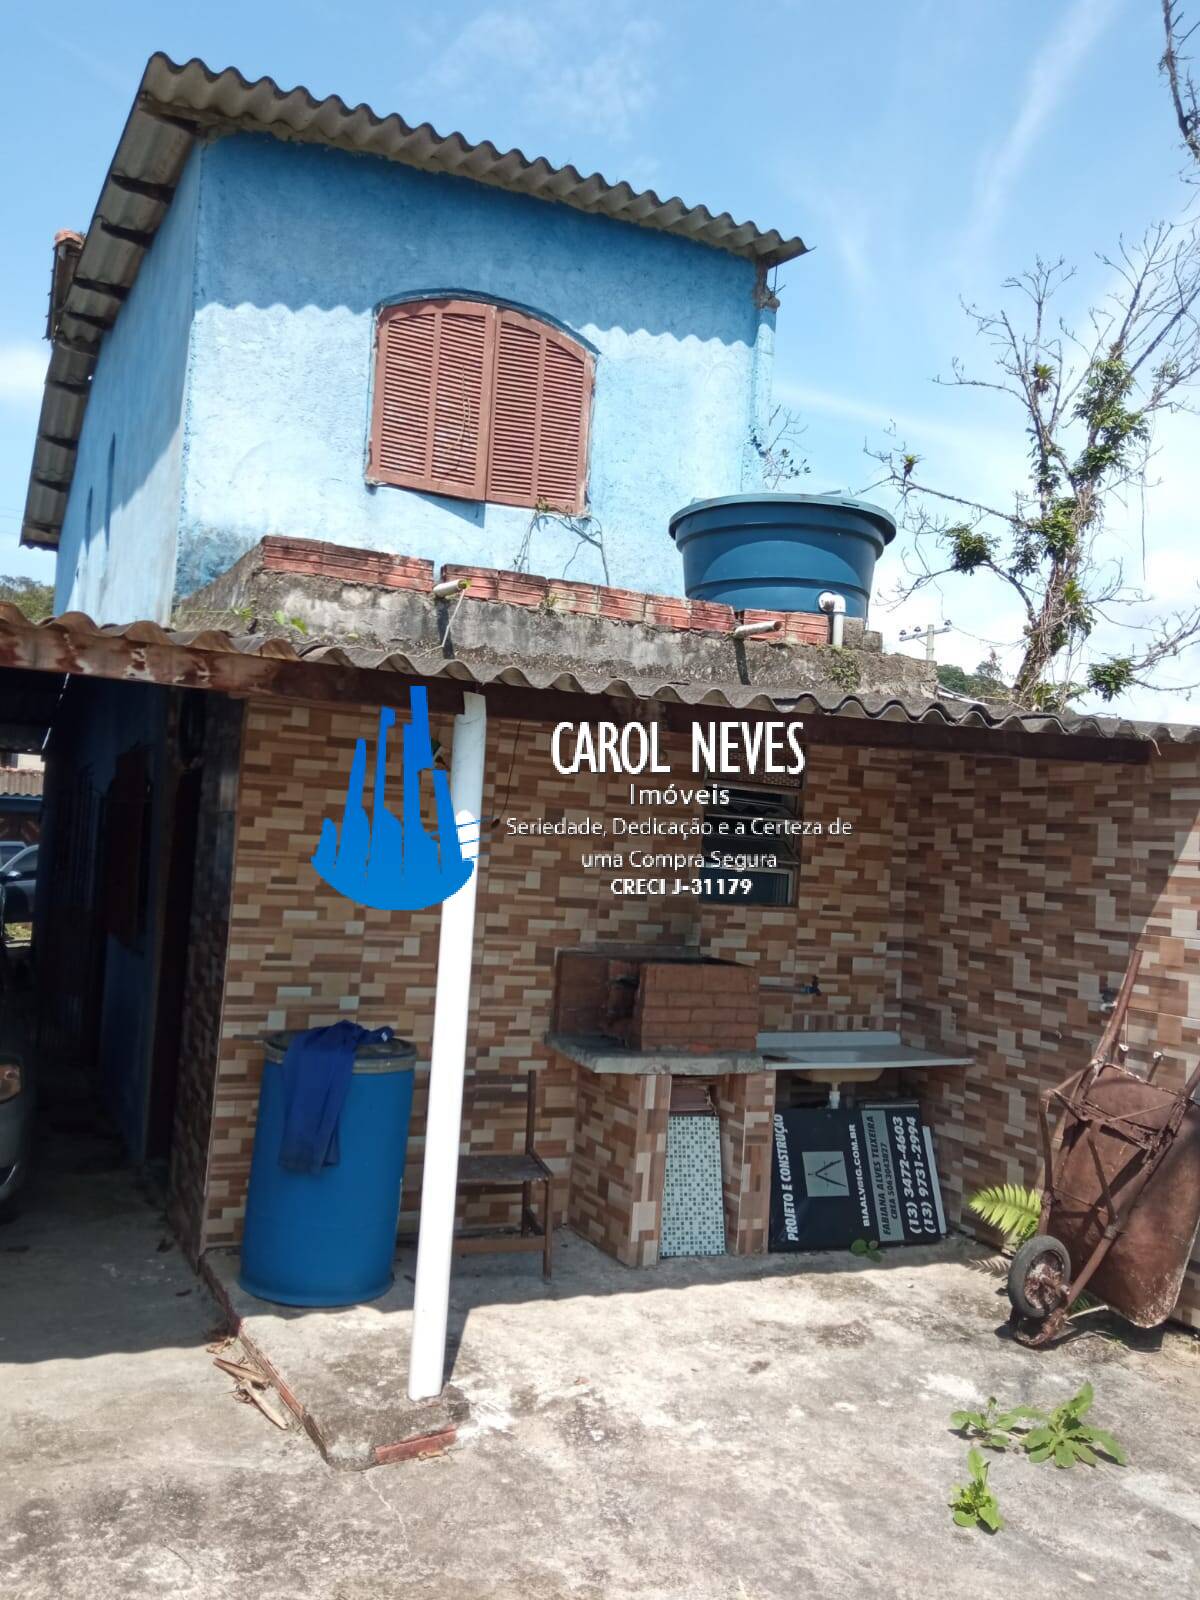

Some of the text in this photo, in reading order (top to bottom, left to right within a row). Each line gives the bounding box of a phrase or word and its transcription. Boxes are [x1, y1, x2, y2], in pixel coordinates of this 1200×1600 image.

[782, 1193, 799, 1241] PROJETO
[866, 1115, 891, 1235] FABIANA ALVES TEIXEIRA
[892, 1116, 922, 1234] (13) 3472-4603
[905, 1116, 936, 1233] (13) 9731-2994
